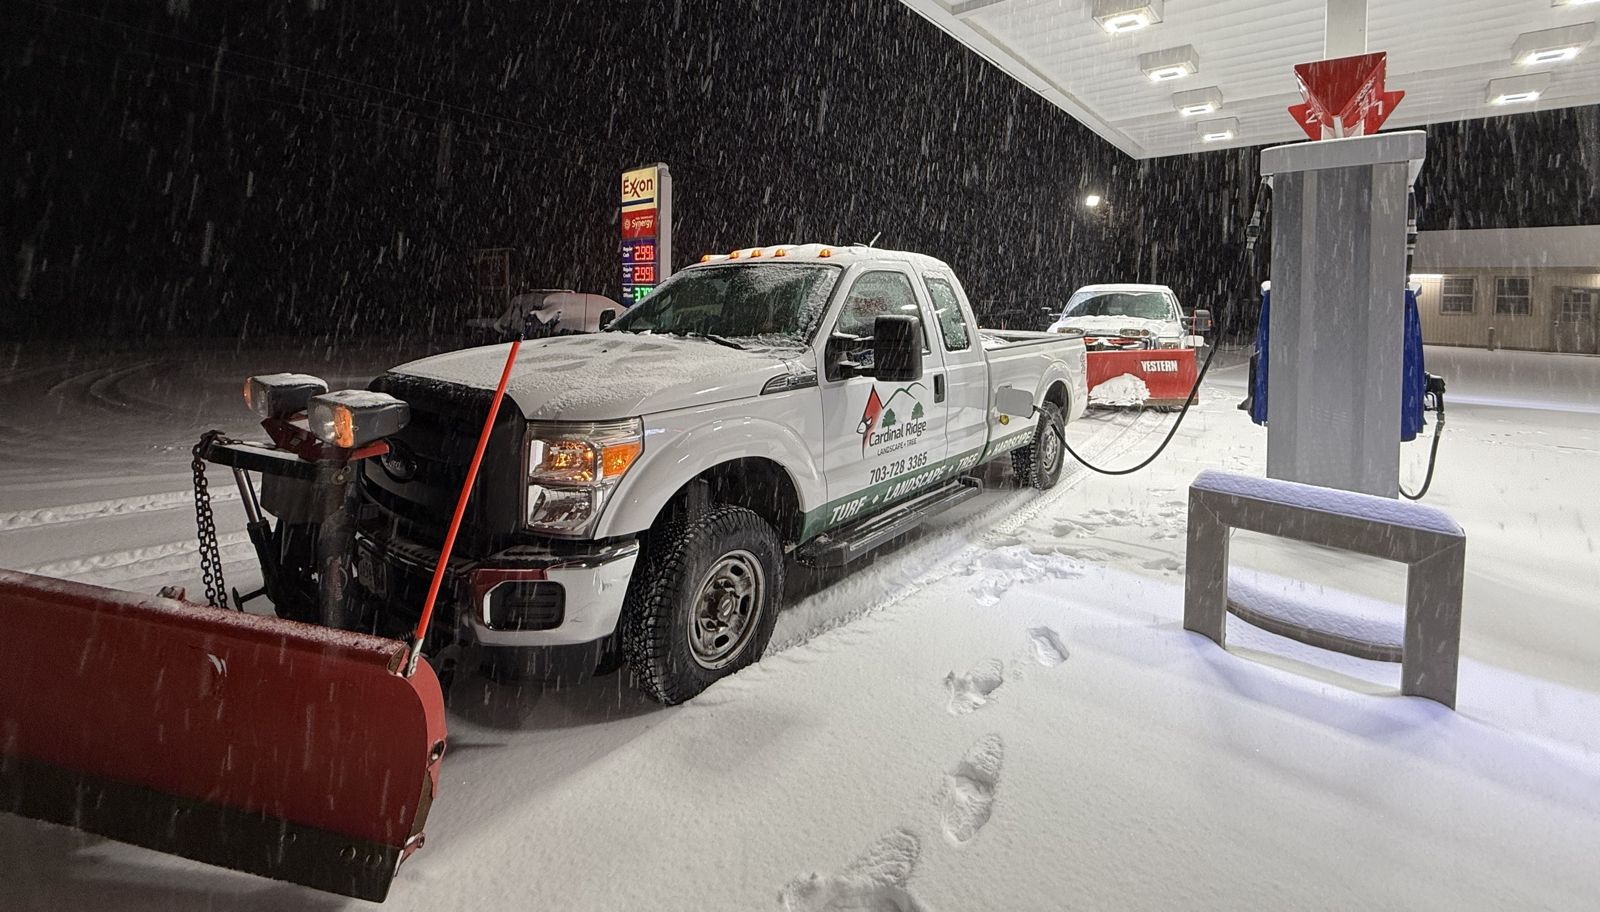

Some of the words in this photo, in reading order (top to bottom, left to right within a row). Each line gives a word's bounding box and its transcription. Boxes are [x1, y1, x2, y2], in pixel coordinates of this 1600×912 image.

[623, 178, 653, 198] Exxon
[631, 218, 653, 231] Synergy
[868, 423, 904, 447] Cardinal
[905, 421, 927, 437] Ridge
[877, 442, 904, 457] LANDSCAPE
[906, 438, 918, 448] TREE
[869, 459, 905, 485] 703-728
[907, 451, 928, 471] 3365
[828, 495, 867, 525] TURF
[882, 465, 947, 503] LANDSCAPE
[955, 452, 979, 472] TREE
